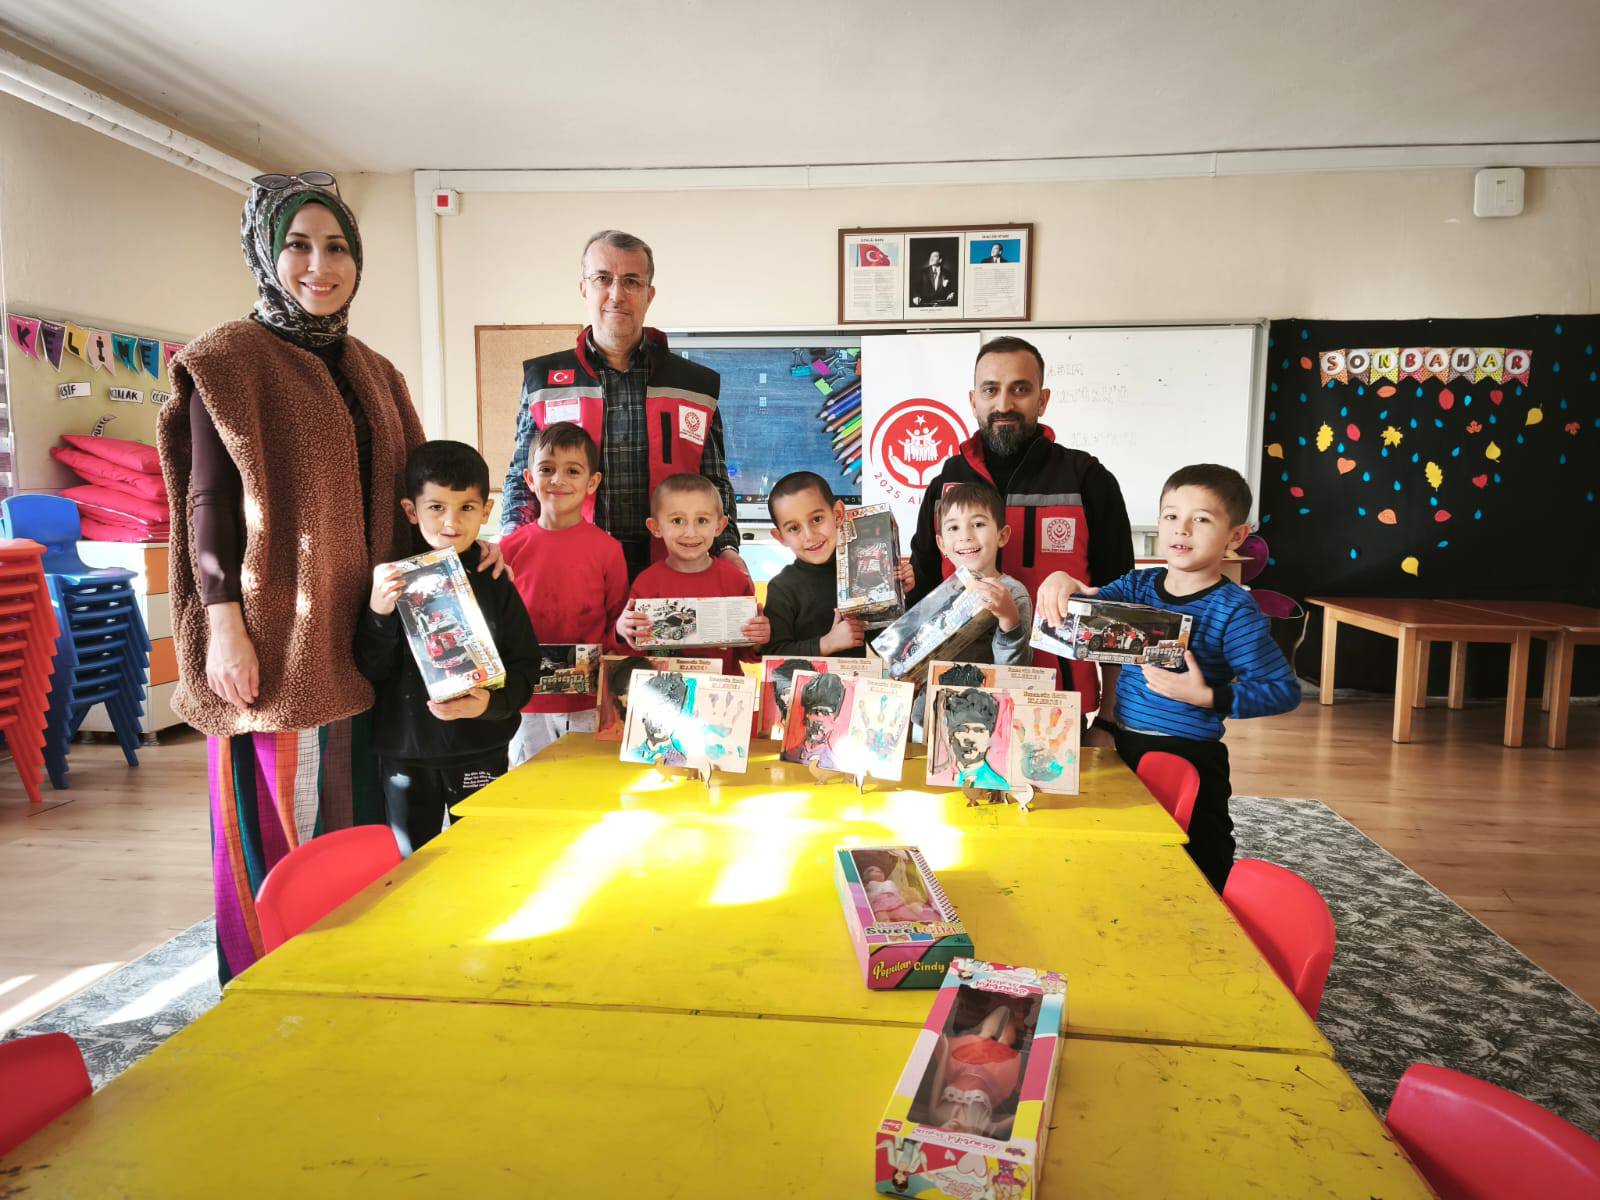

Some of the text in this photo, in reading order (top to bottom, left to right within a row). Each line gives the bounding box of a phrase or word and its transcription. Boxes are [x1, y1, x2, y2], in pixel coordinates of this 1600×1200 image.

[17, 324, 152, 366] KELİME
[1327, 353, 1524, 371] SONBAHAR
[873, 471, 901, 499] 2025
[873, 960, 945, 979] Popular Cindy
